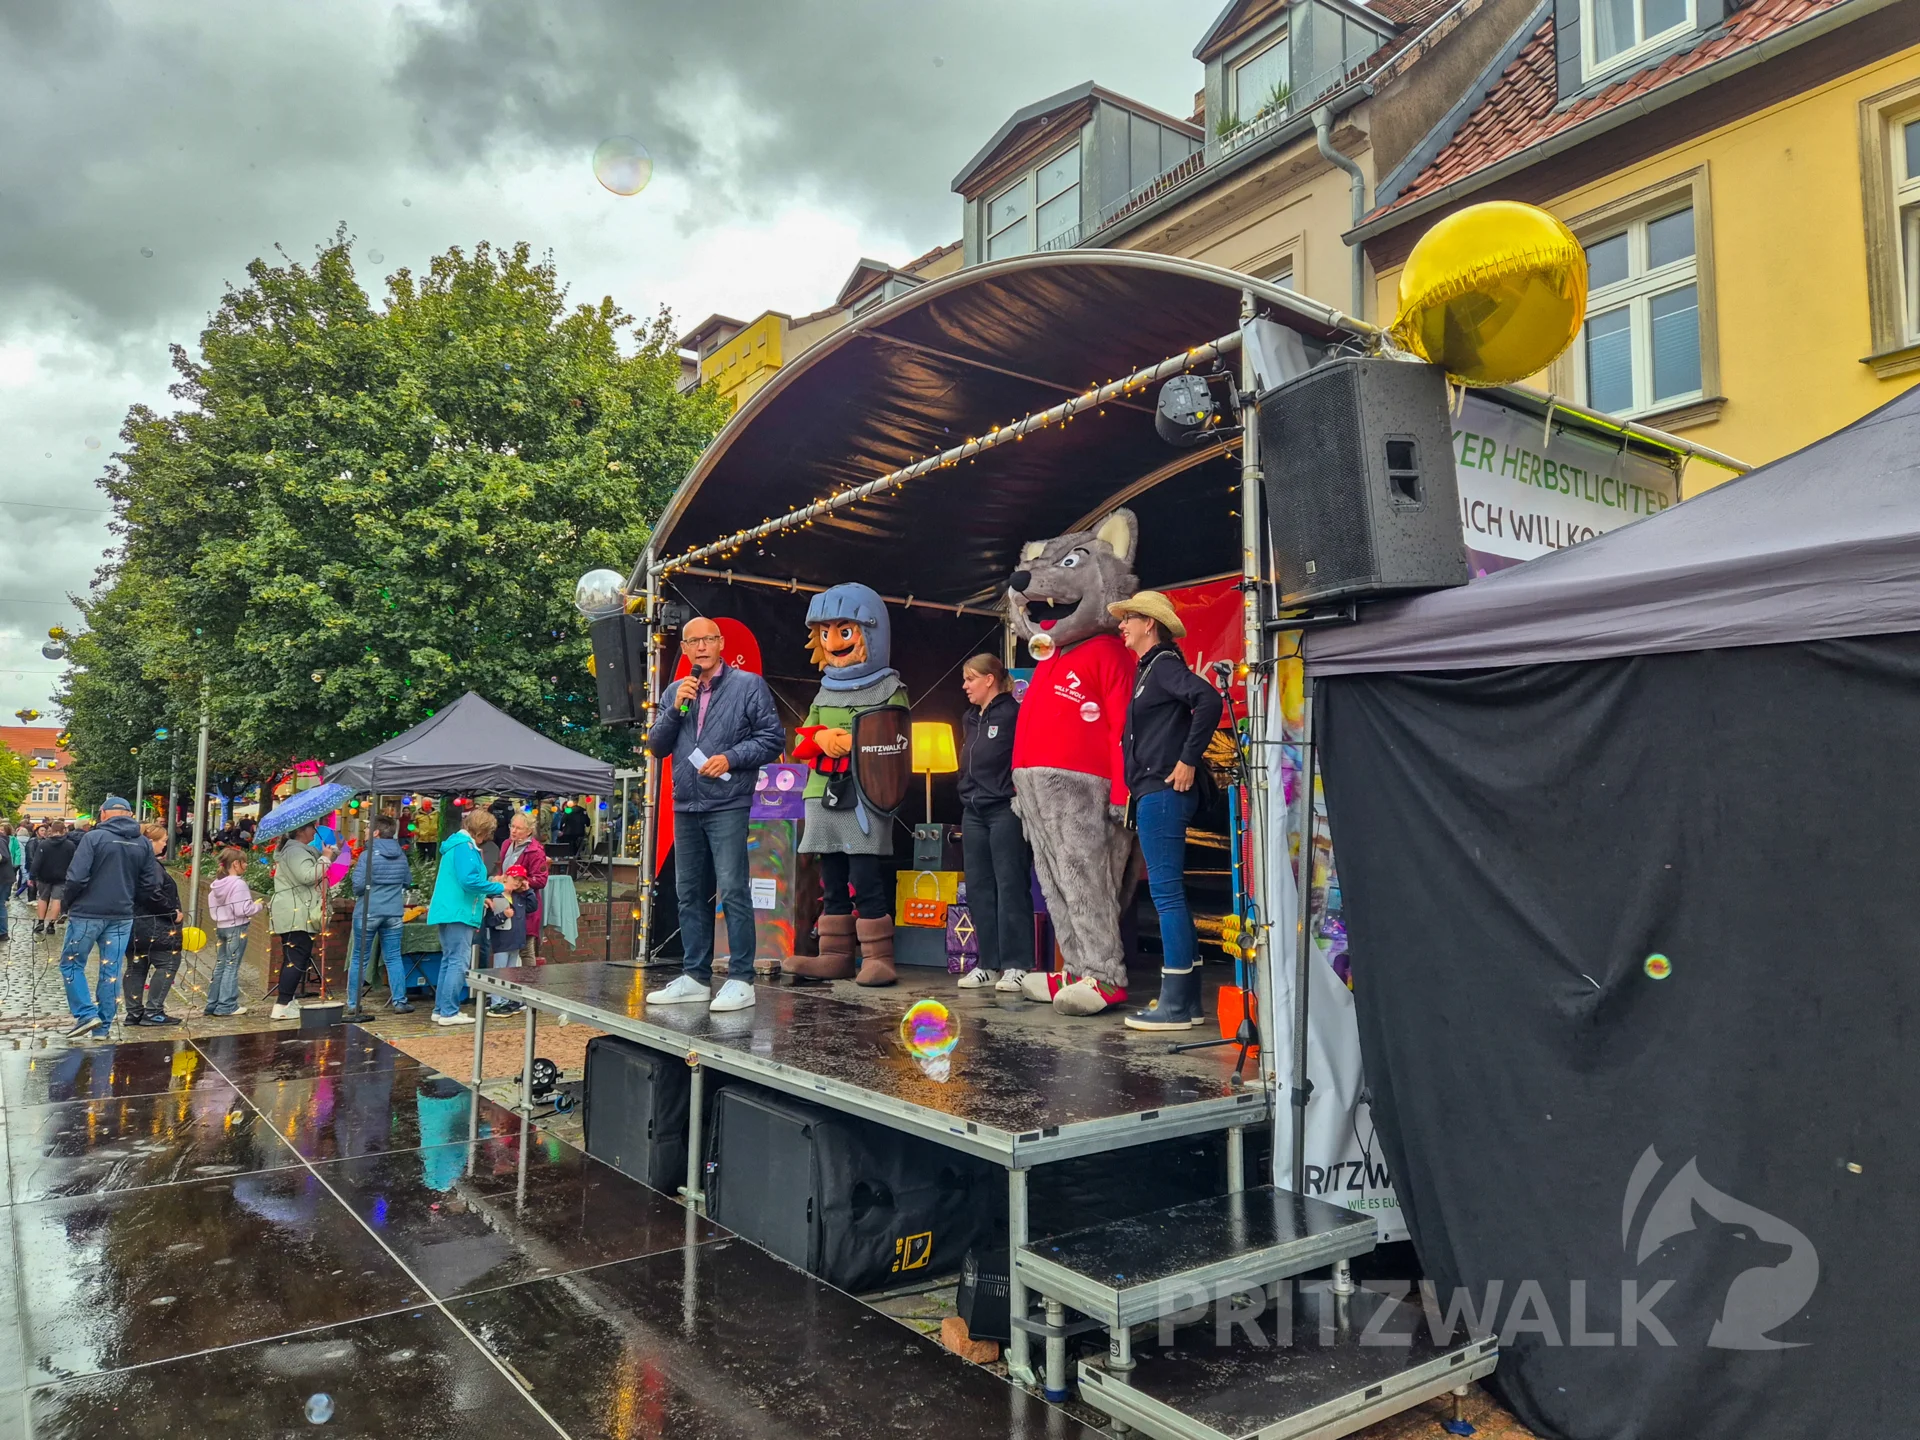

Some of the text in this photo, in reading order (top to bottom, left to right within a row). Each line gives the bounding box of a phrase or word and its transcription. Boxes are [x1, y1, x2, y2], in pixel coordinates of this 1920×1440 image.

[1462, 497, 1604, 550] ICH WILLKO
[861, 744, 902, 753] PRITZWALK
[1347, 1199, 1366, 1210] WIE
[1368, 1198, 1380, 1209] ES
